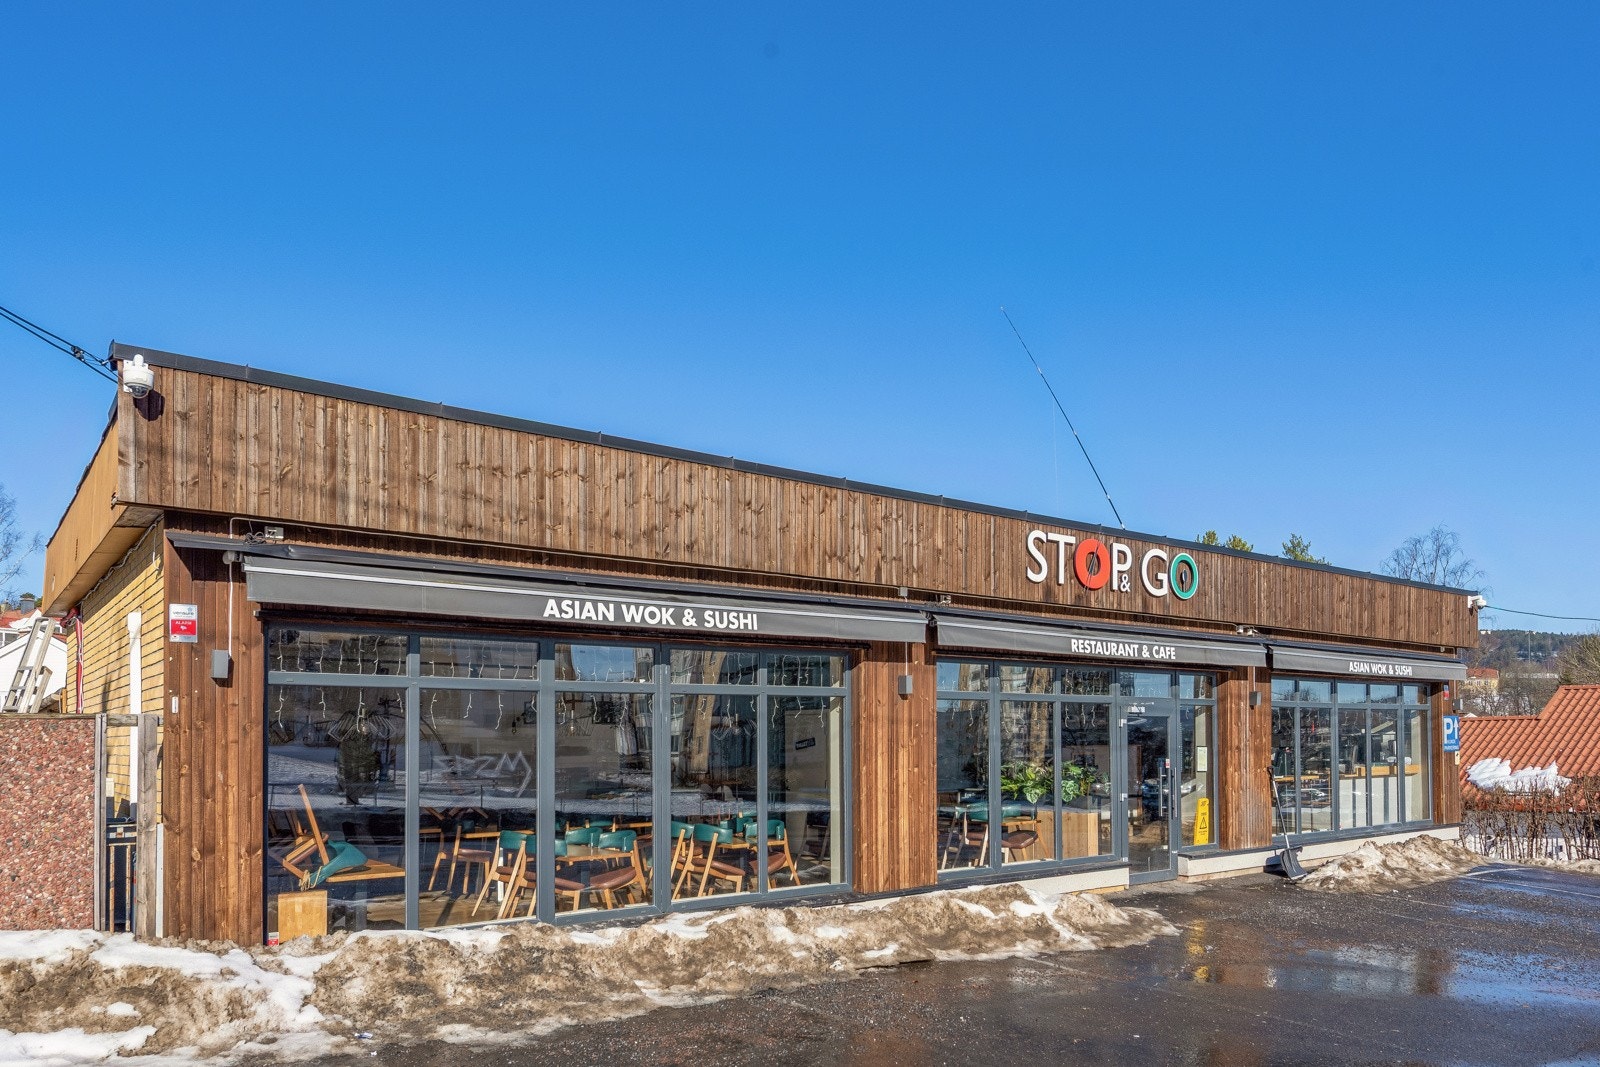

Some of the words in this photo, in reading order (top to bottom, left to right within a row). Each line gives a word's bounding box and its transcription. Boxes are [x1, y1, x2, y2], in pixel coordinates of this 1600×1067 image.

[1026, 529, 1133, 591] STOP
[1119, 573, 1131, 593] &
[1141, 548, 1199, 600] GO
[543, 598, 614, 621] ASIAN
[621, 604, 676, 626] WOK
[682, 608, 698, 627] &
[703, 610, 758, 631] SUSHI
[1071, 639, 1139, 657] RESTAURANT
[1141, 645, 1151, 658] &
[1152, 645, 1176, 660] CAFE
[1349, 661, 1370, 673] ASIAN
[1370, 663, 1388, 675] WOK
[1388, 664, 1394, 675] &
[1395, 665, 1413, 676] SUSHI
[1443, 717, 1454, 744] P
